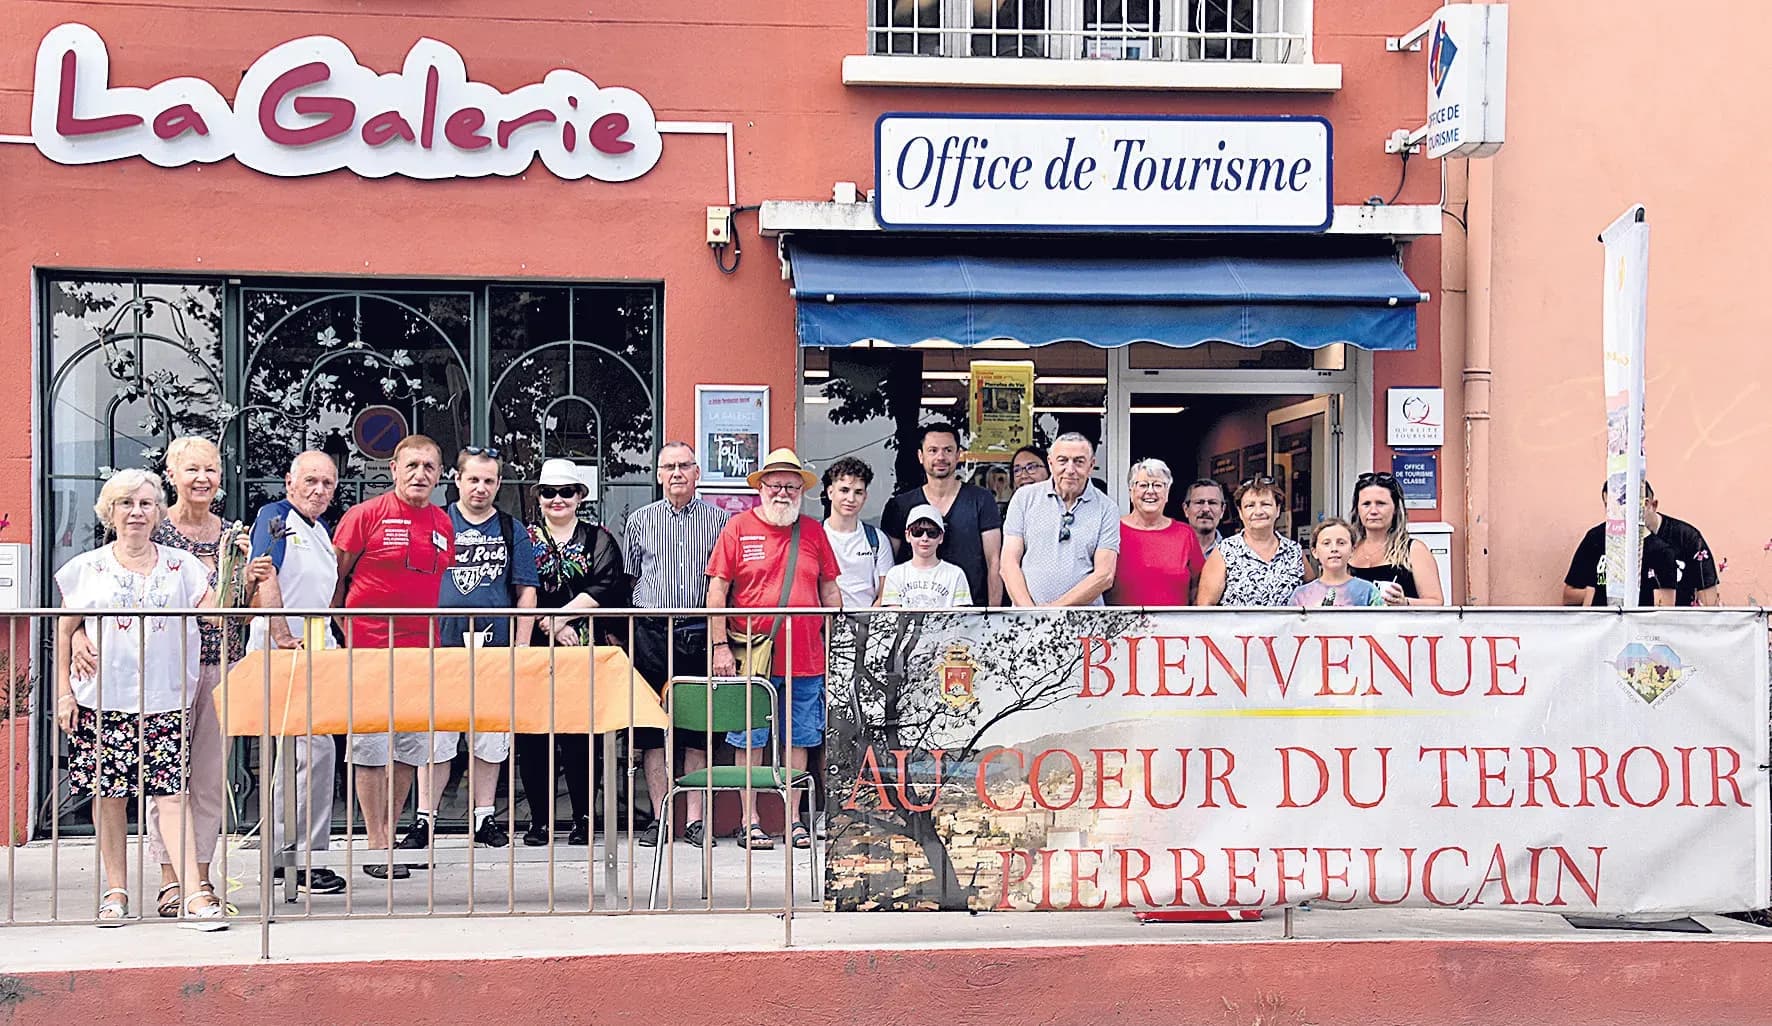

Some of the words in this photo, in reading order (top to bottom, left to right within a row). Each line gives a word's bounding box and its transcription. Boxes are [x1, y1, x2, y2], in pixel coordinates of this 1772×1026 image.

[56, 49, 209, 139] La
[258, 61, 635, 155] Galerie
[1447, 104, 1459, 120] DE
[896, 135, 1032, 208] Office
[1044, 137, 1096, 191] de
[1112, 138, 1312, 192] Tourisme
[471, 545, 506, 563] Rock
[1077, 634, 1527, 700] BIENVENUE
[843, 745, 947, 813] AU
[975, 747, 1247, 812] COEUR
[1276, 746, 1393, 809] DU
[1419, 745, 1752, 809] TERROIR
[998, 842, 1608, 910] PIERREFEUCAIN
